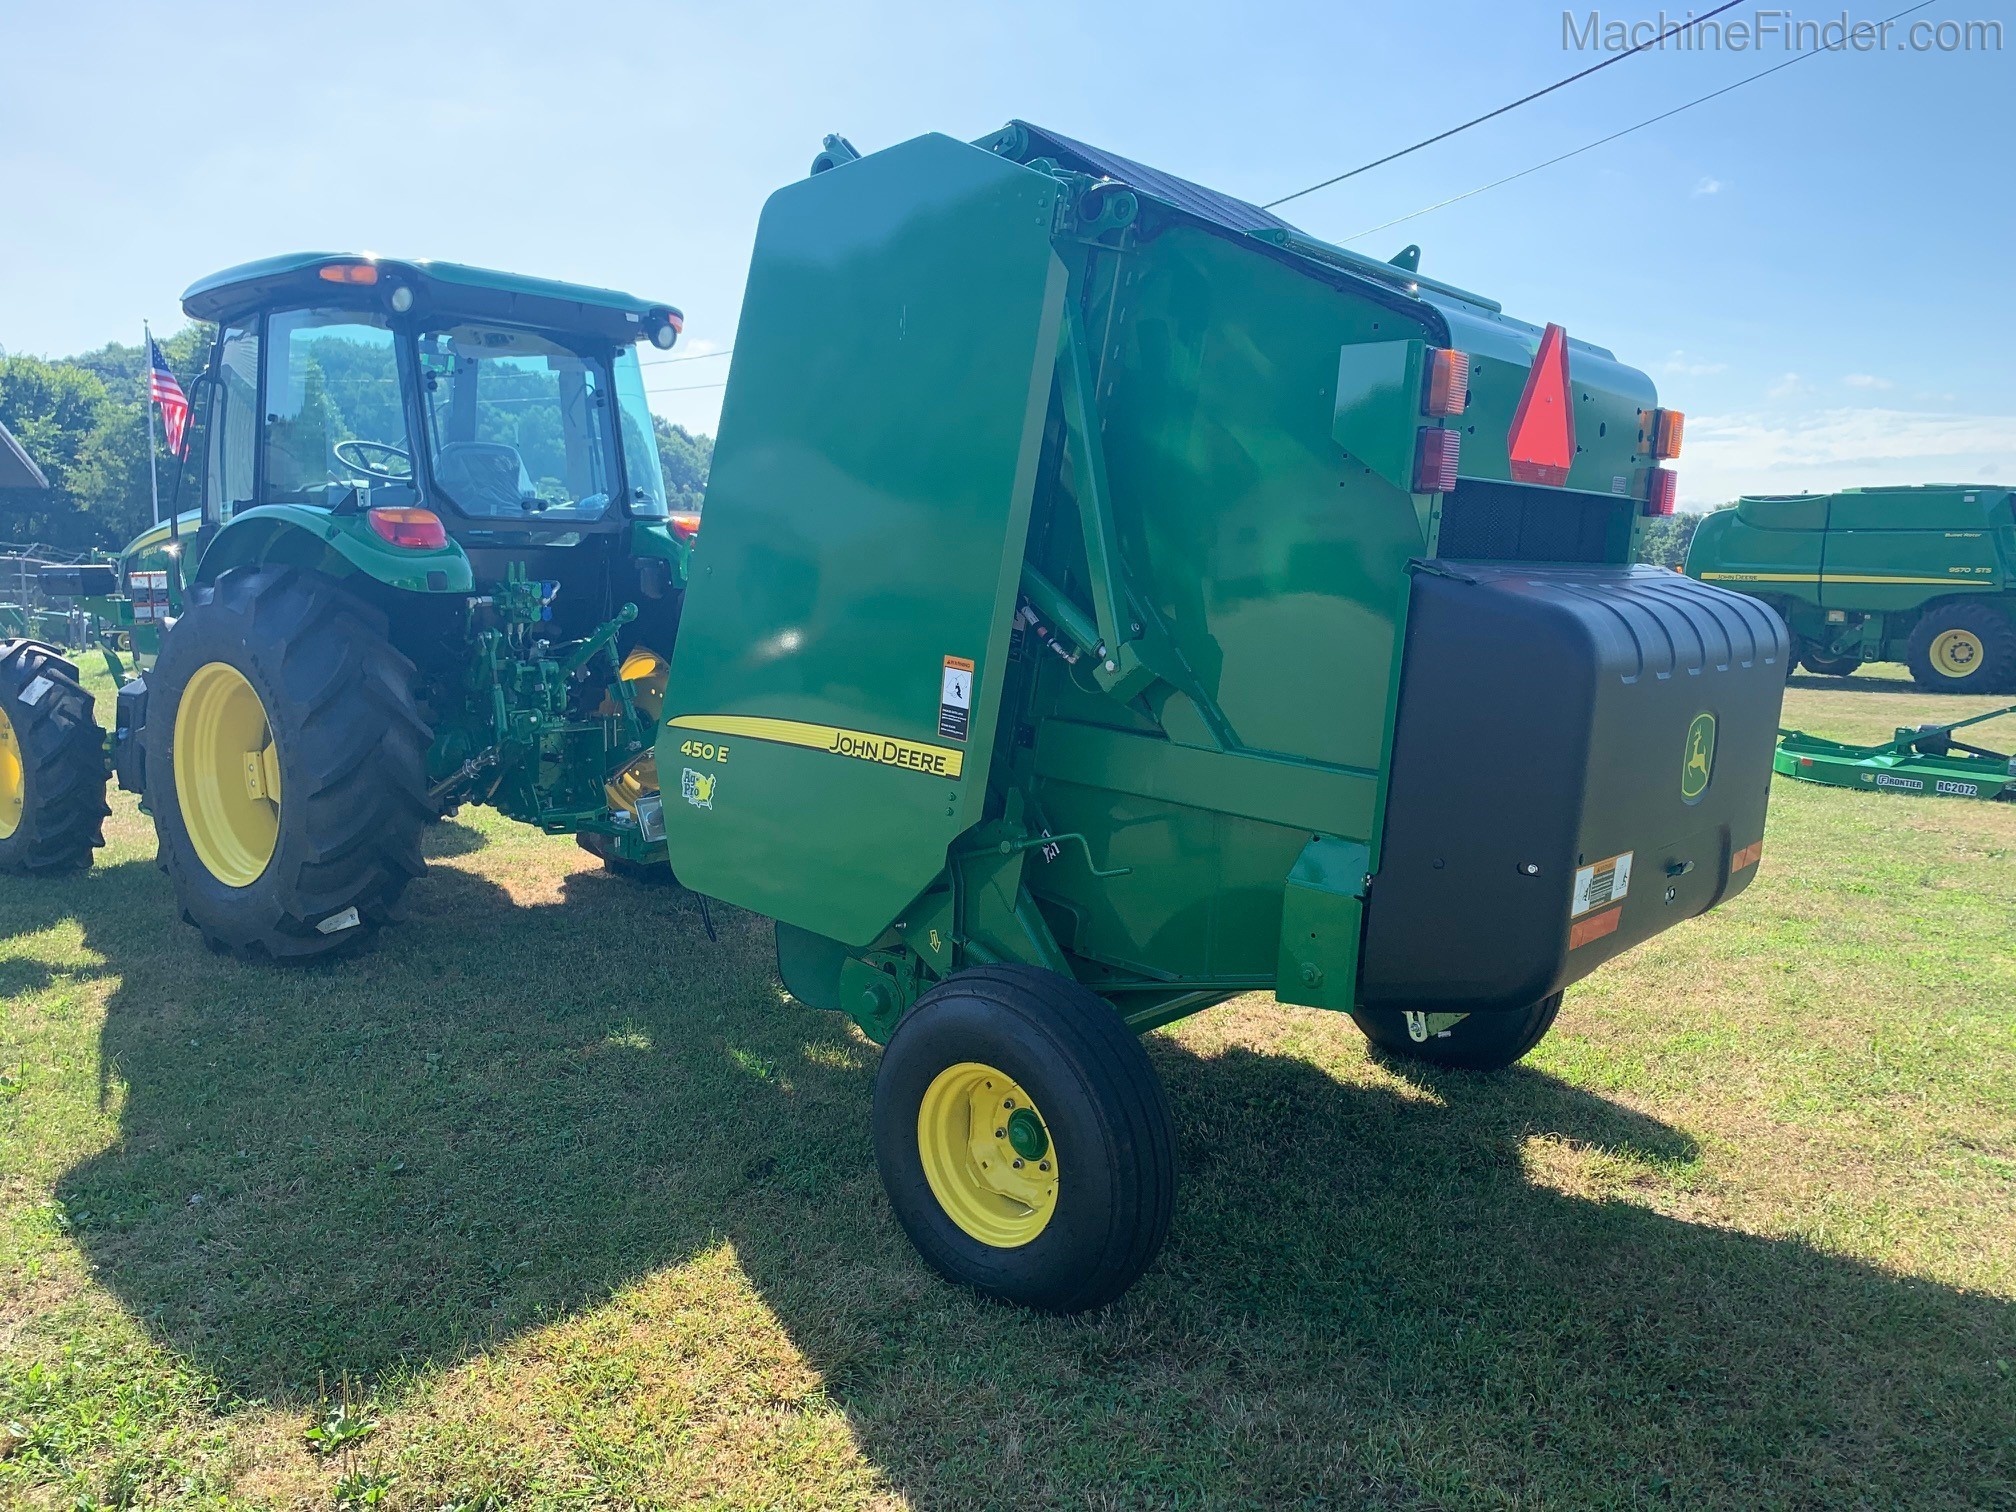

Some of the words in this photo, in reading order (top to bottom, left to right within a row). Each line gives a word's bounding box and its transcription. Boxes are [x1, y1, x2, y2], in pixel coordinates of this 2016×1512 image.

[680, 740, 715, 760] 450
[717, 746, 730, 763] E
[829, 732, 879, 759] JOHN
[882, 741, 947, 773] DEERE
[684, 783, 699, 797] Pro
[1878, 774, 1923, 789] FRONTIER
[1937, 781, 1977, 795] RC2072
